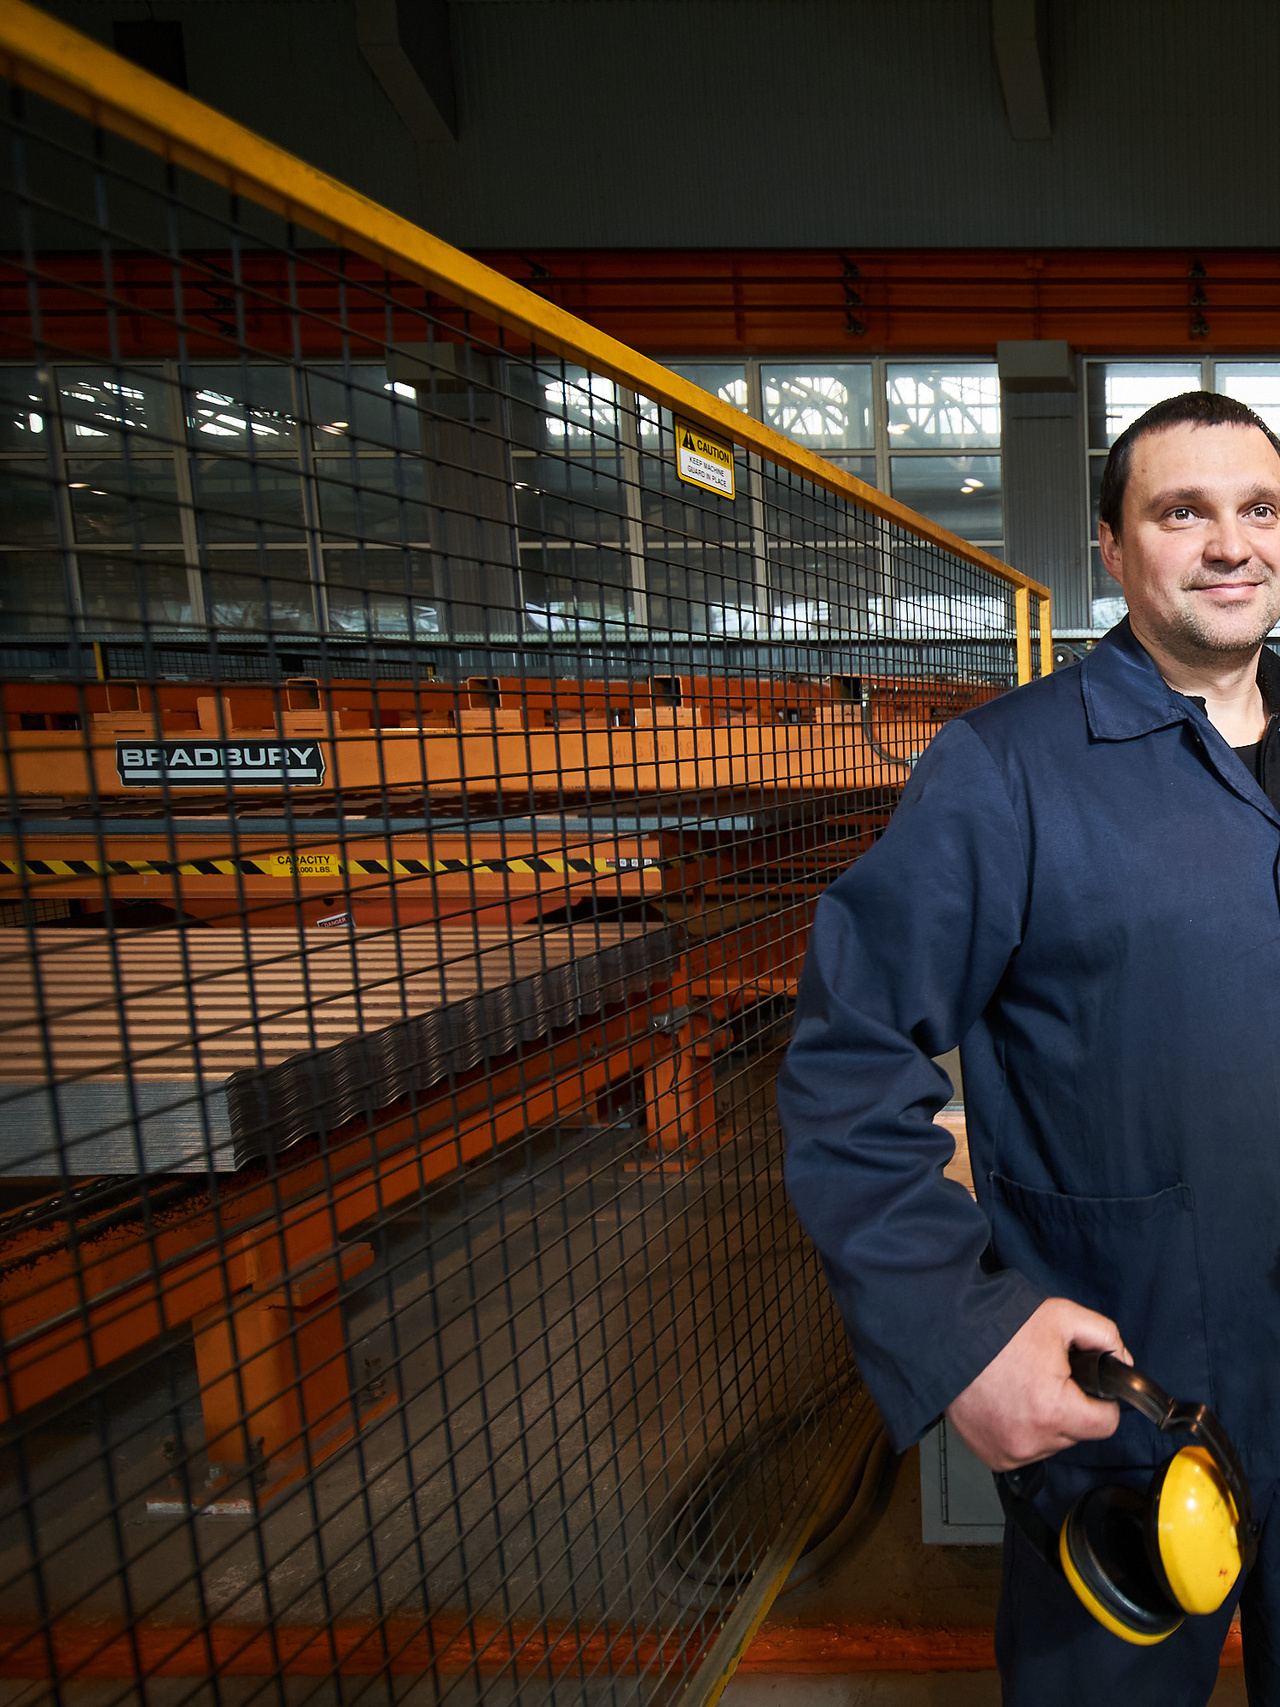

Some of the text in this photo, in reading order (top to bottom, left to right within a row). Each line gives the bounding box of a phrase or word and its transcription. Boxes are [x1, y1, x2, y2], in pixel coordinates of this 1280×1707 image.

[697, 440, 729, 464] CAUTION
[687, 465, 728, 488] GUARD IN PLACE
[689, 456, 725, 478] KEEP MACHINE
[121, 747, 314, 767] BRADBURY
[277, 855, 330, 865] CAPACITY
[324, 917, 347, 928] DANGER
